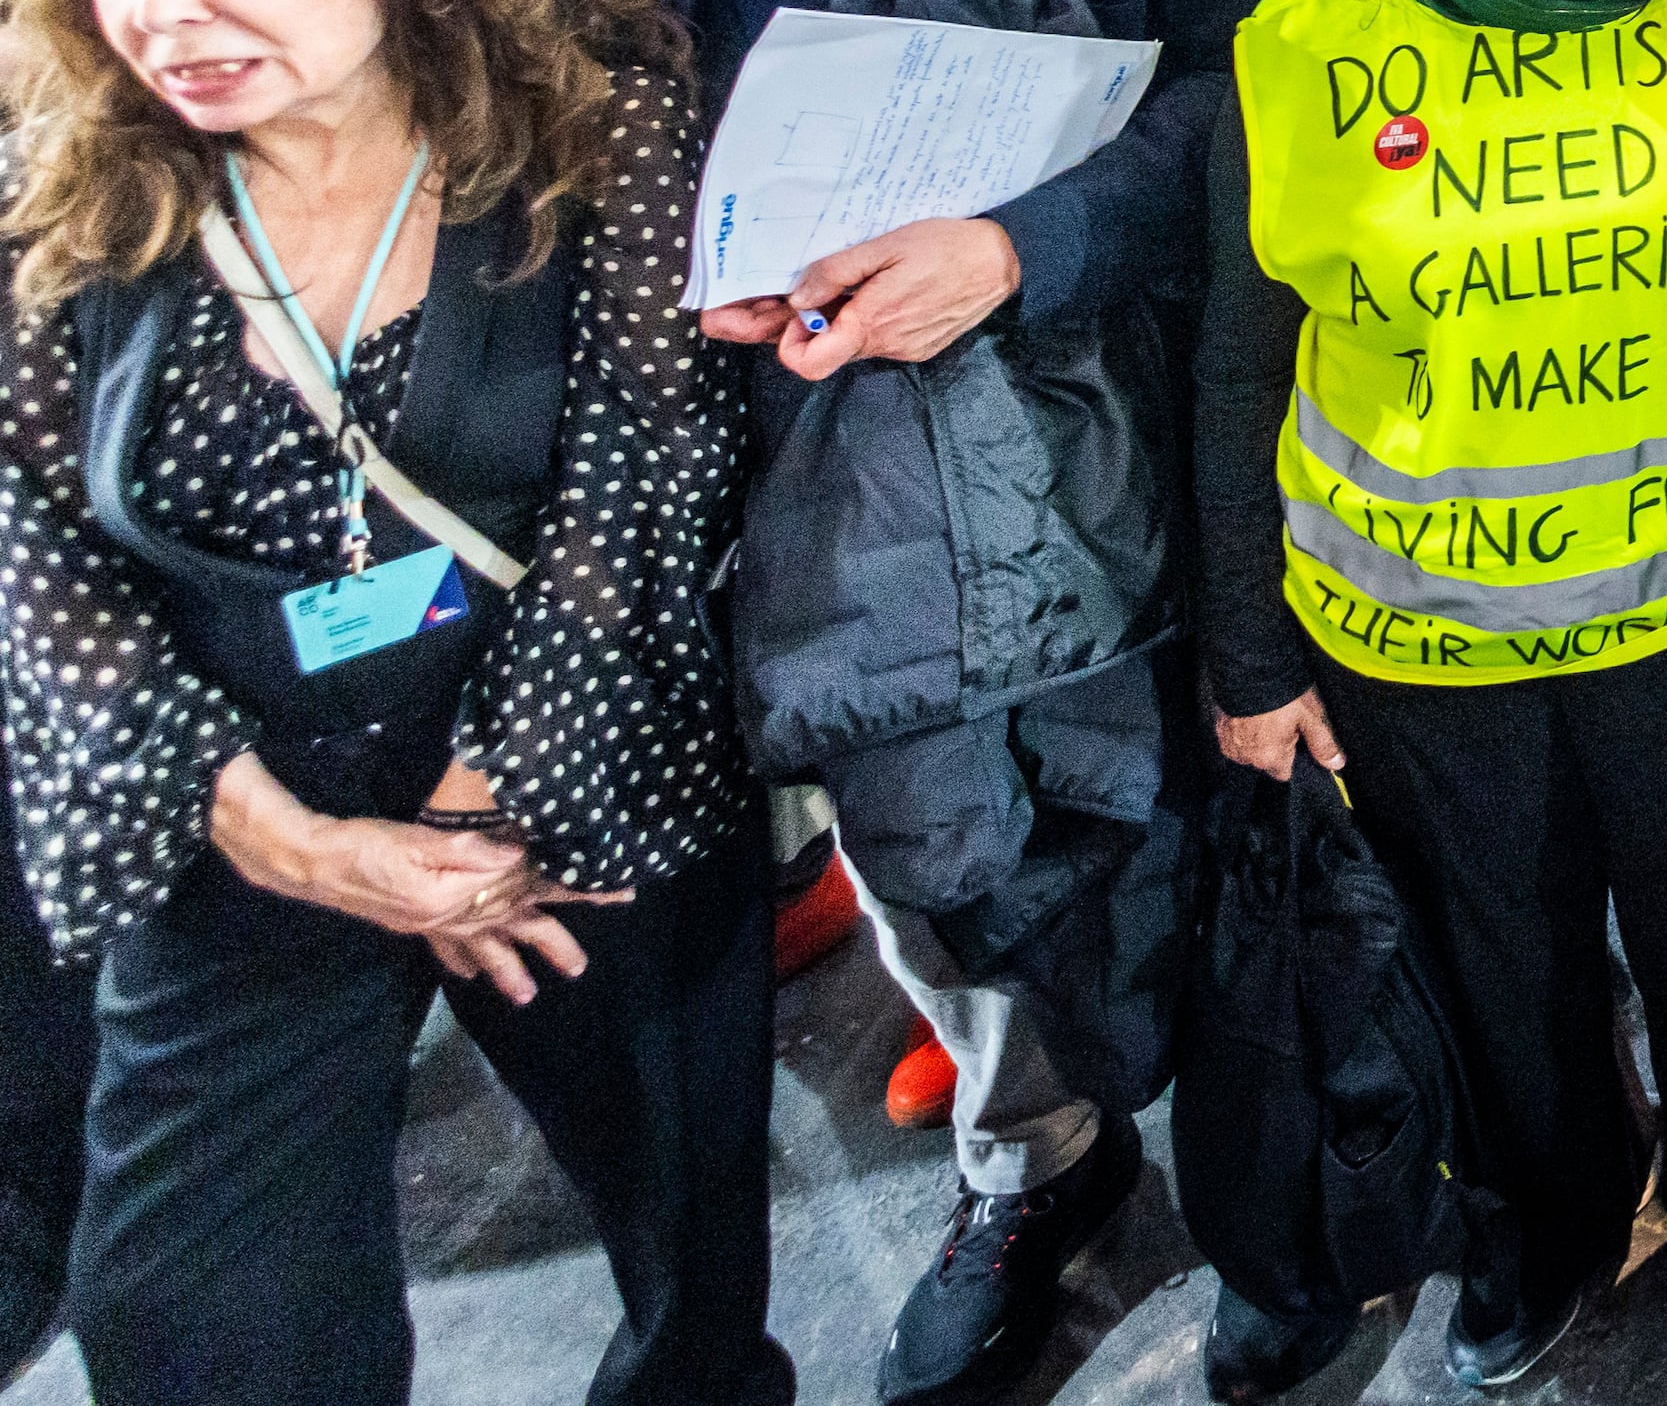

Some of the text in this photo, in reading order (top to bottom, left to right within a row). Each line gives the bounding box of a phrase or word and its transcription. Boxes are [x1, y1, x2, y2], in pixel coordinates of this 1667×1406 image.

[1326, 43, 1429, 138] DO
[1378, 132, 1419, 148] CULTURAL
[1389, 123, 1404, 136] IVA
[1431, 124, 1657, 218] NEED
[1349, 261, 1392, 327] A
[1471, 333, 1652, 414] MAKE
